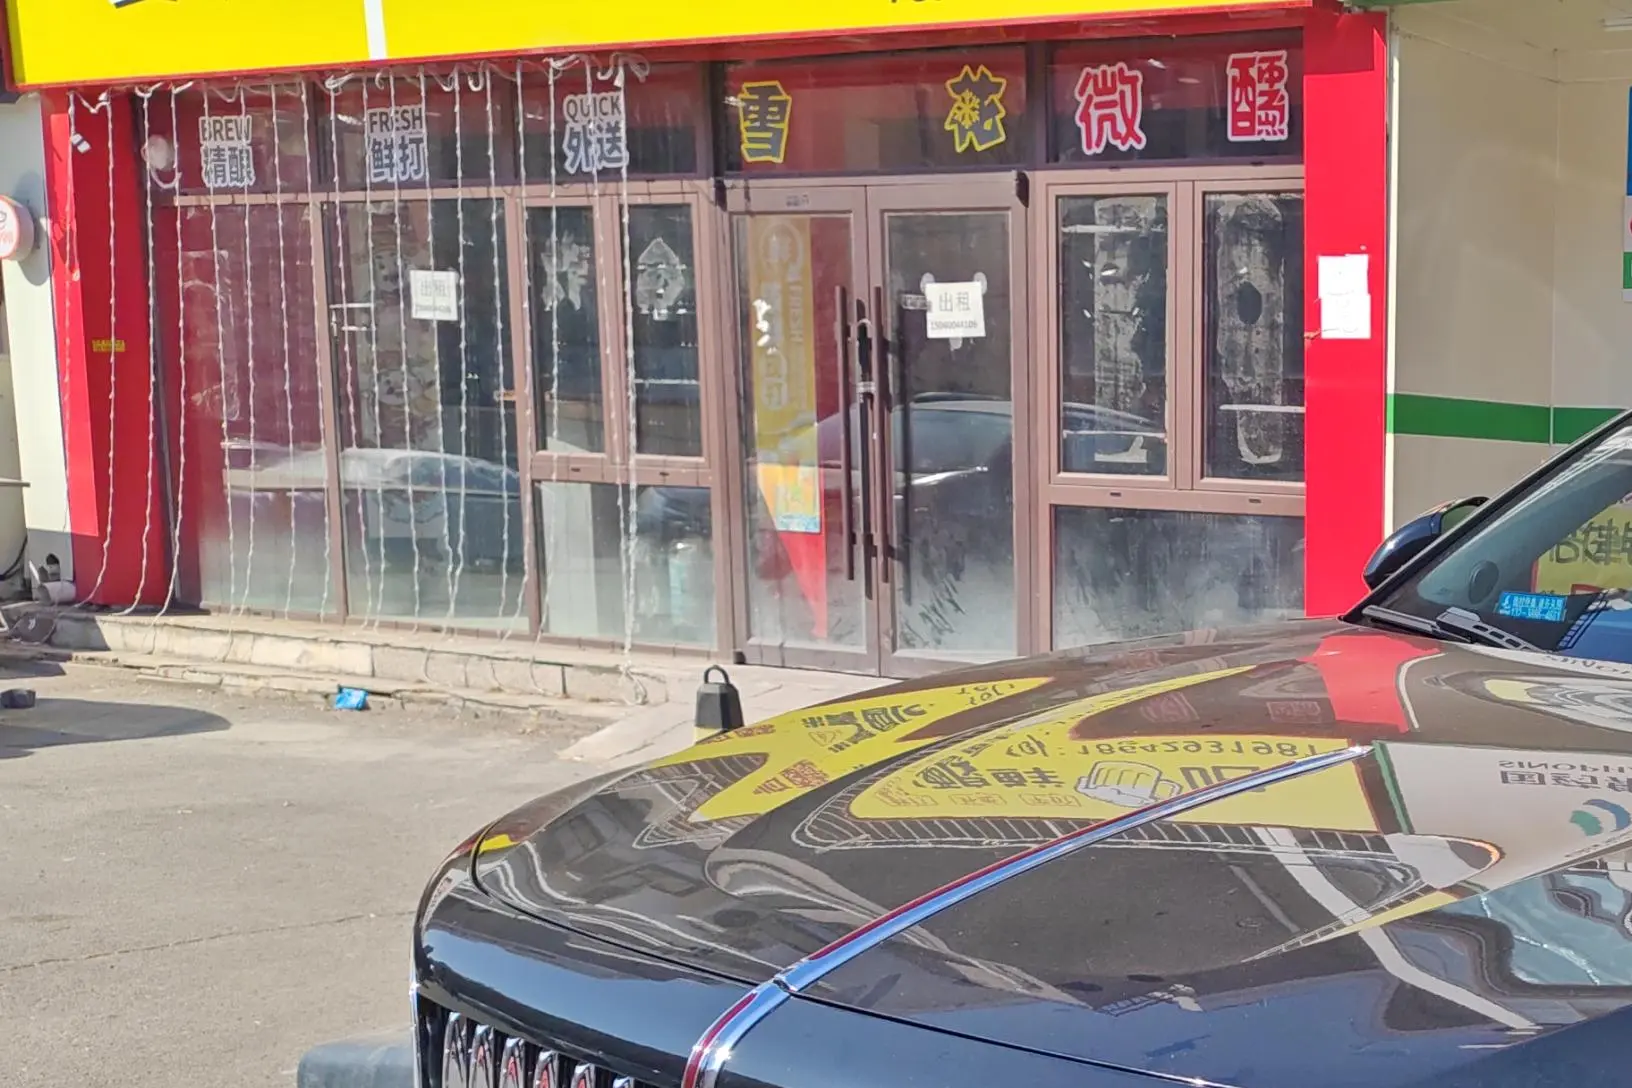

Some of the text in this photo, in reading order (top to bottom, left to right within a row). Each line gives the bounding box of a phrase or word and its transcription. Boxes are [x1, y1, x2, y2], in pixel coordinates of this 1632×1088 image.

[368, 107, 422, 134] FRESH
[565, 95, 622, 122] QUICK
[201, 117, 251, 142] BREW
[367, 136, 425, 180] 鲜打
[563, 122, 626, 173] 外送
[203, 145, 254, 186] 精酿
[939, 291, 971, 313] 出租
